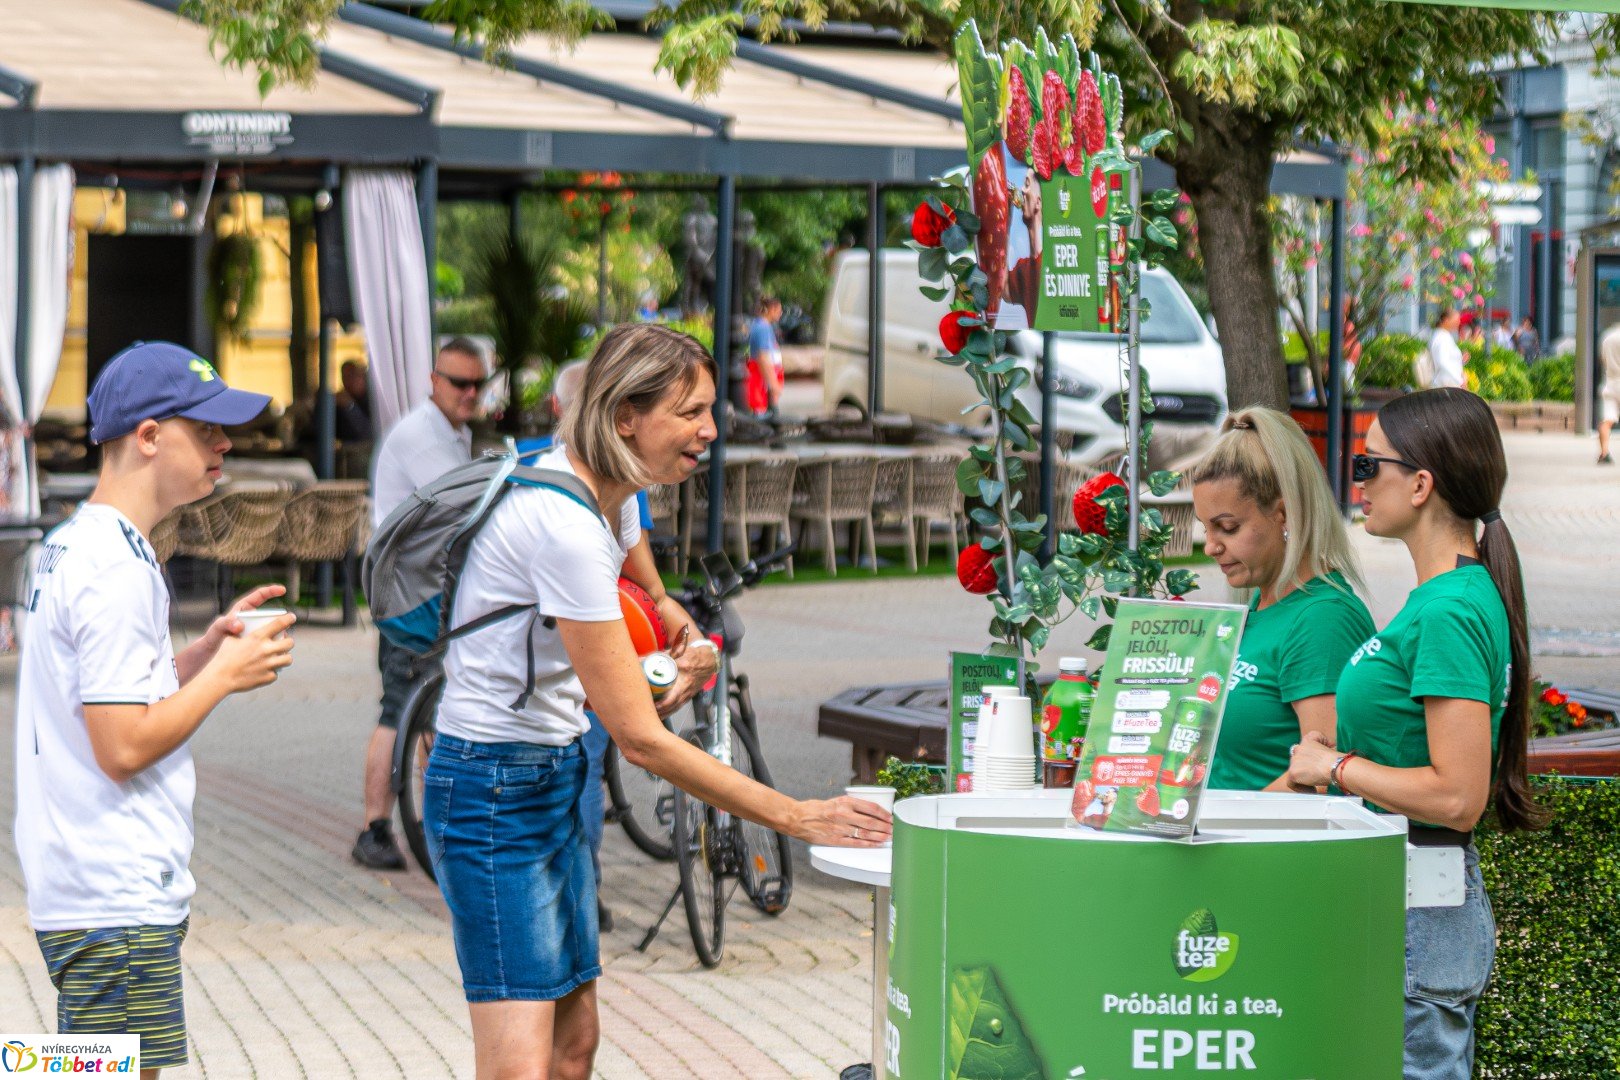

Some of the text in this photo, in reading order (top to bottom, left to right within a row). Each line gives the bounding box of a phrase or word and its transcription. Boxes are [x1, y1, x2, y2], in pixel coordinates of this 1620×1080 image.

[181, 112, 292, 134] CONTINENT
[1055, 244, 1079, 268] EPER
[1045, 266, 1091, 297] ÉS DINNYE
[1131, 619, 1206, 637] POSZTOLJ,
[1126, 637, 1169, 656] JELÖLJ,
[962, 664, 1002, 679] POSZTOLJ,
[1122, 652, 1196, 676] FRISSÜLJ!
[1123, 719, 1158, 727] #FuzeTea
[1172, 723, 1201, 743] fuze
[1168, 737, 1192, 753] tea
[1178, 930, 1230, 952] fuze
[1178, 950, 1217, 968] tea
[1103, 993, 1283, 1018] Próbáld ki a tea,
[1132, 1029, 1257, 1070] EPER
